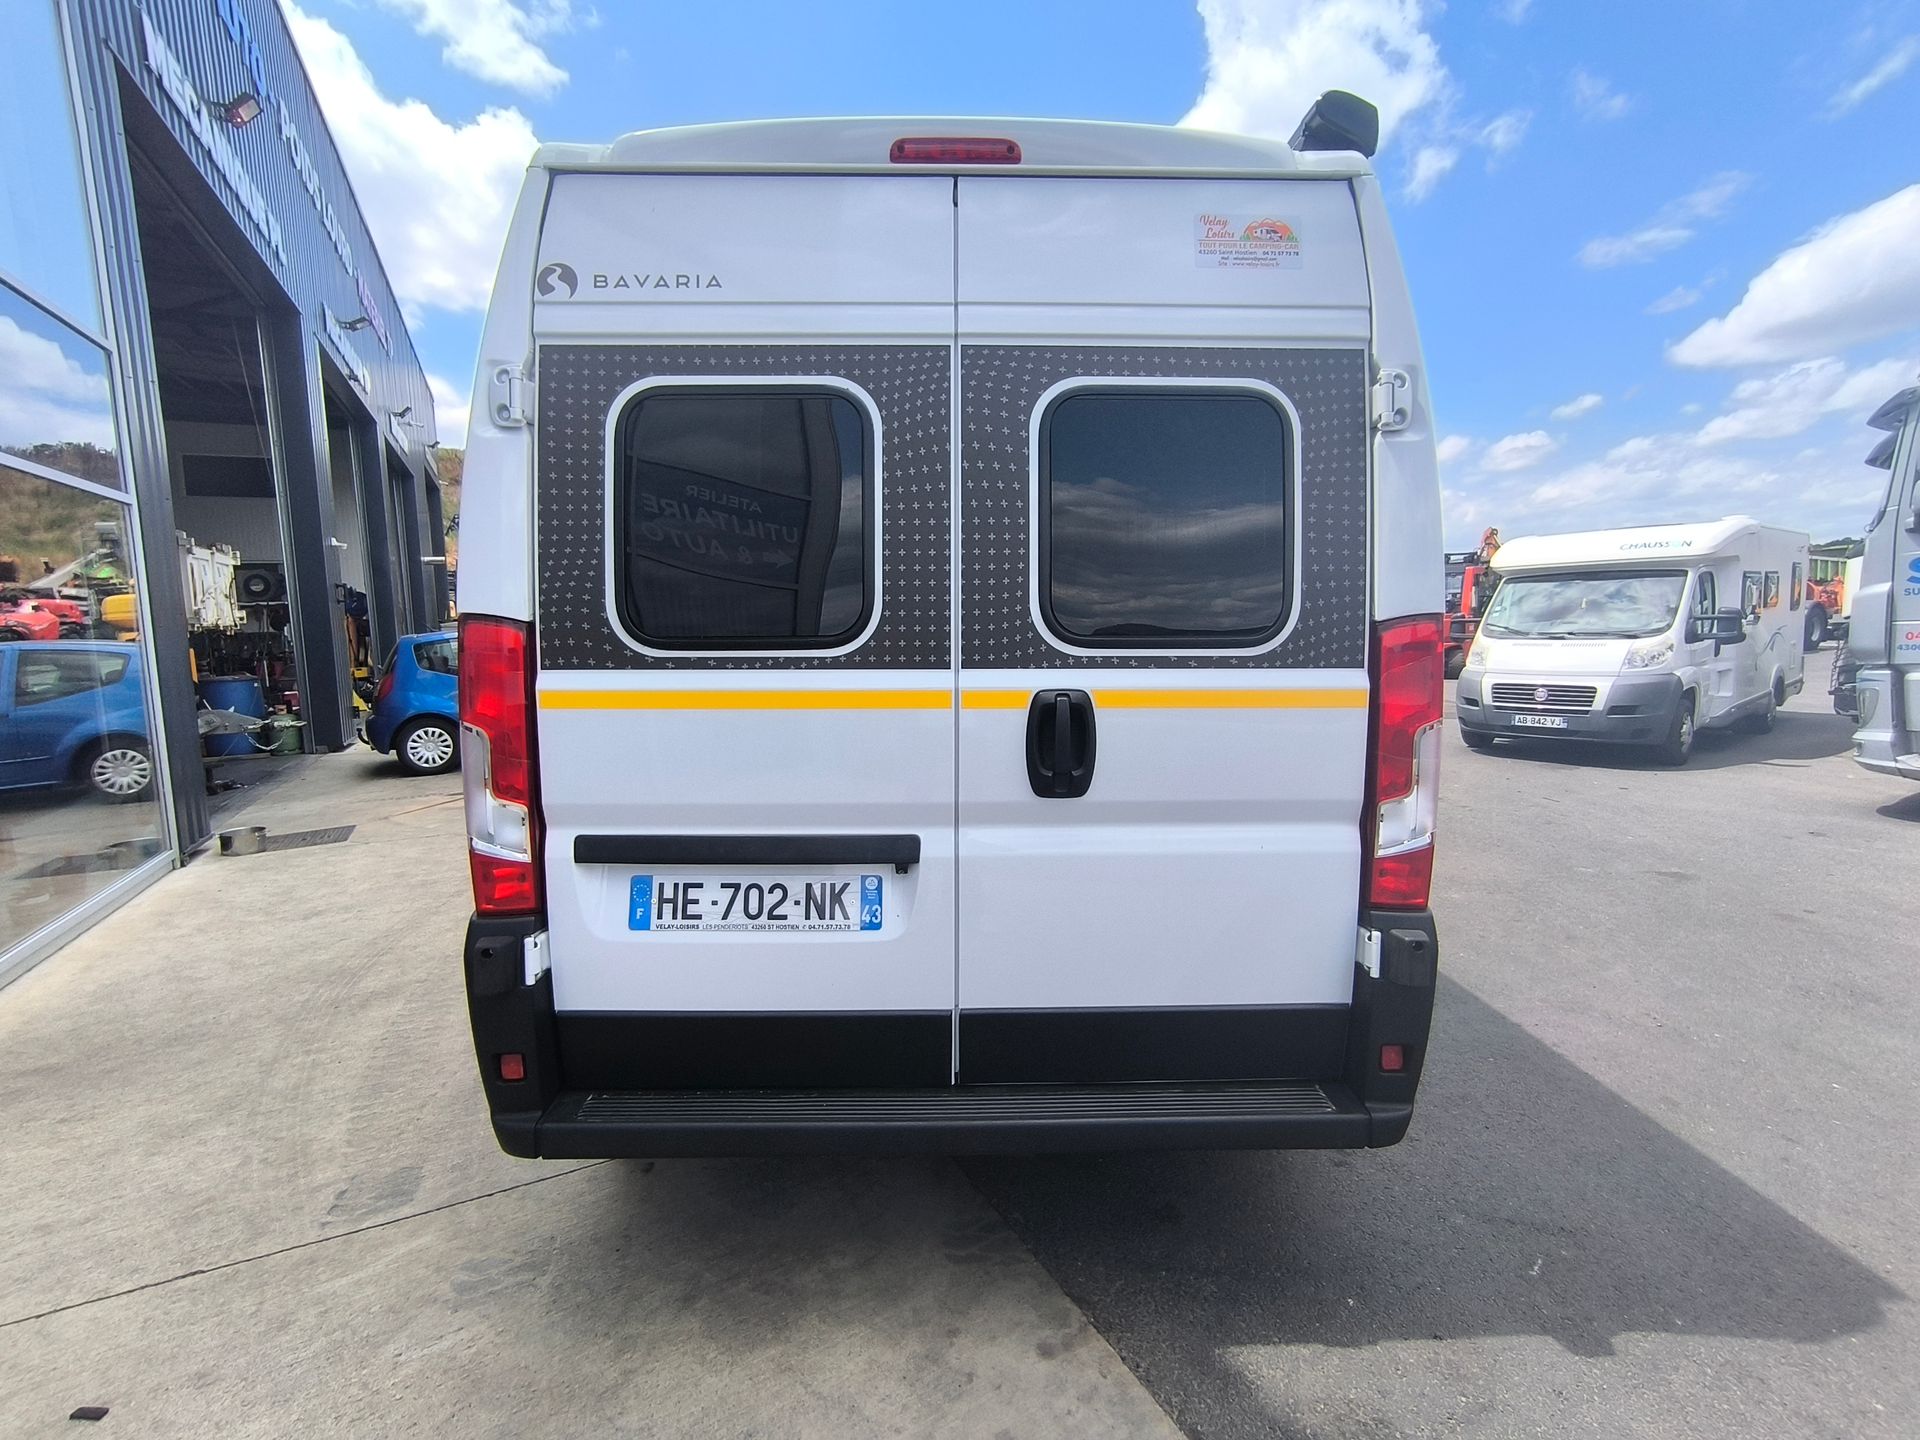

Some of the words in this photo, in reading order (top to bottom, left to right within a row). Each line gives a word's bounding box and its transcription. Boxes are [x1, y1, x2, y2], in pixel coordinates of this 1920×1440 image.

[594, 274, 723, 289] BAVARIA
[656, 882, 851, 921] HE-702-NK
[636, 909, 644, 919] F
[861, 904, 882, 923] 43
